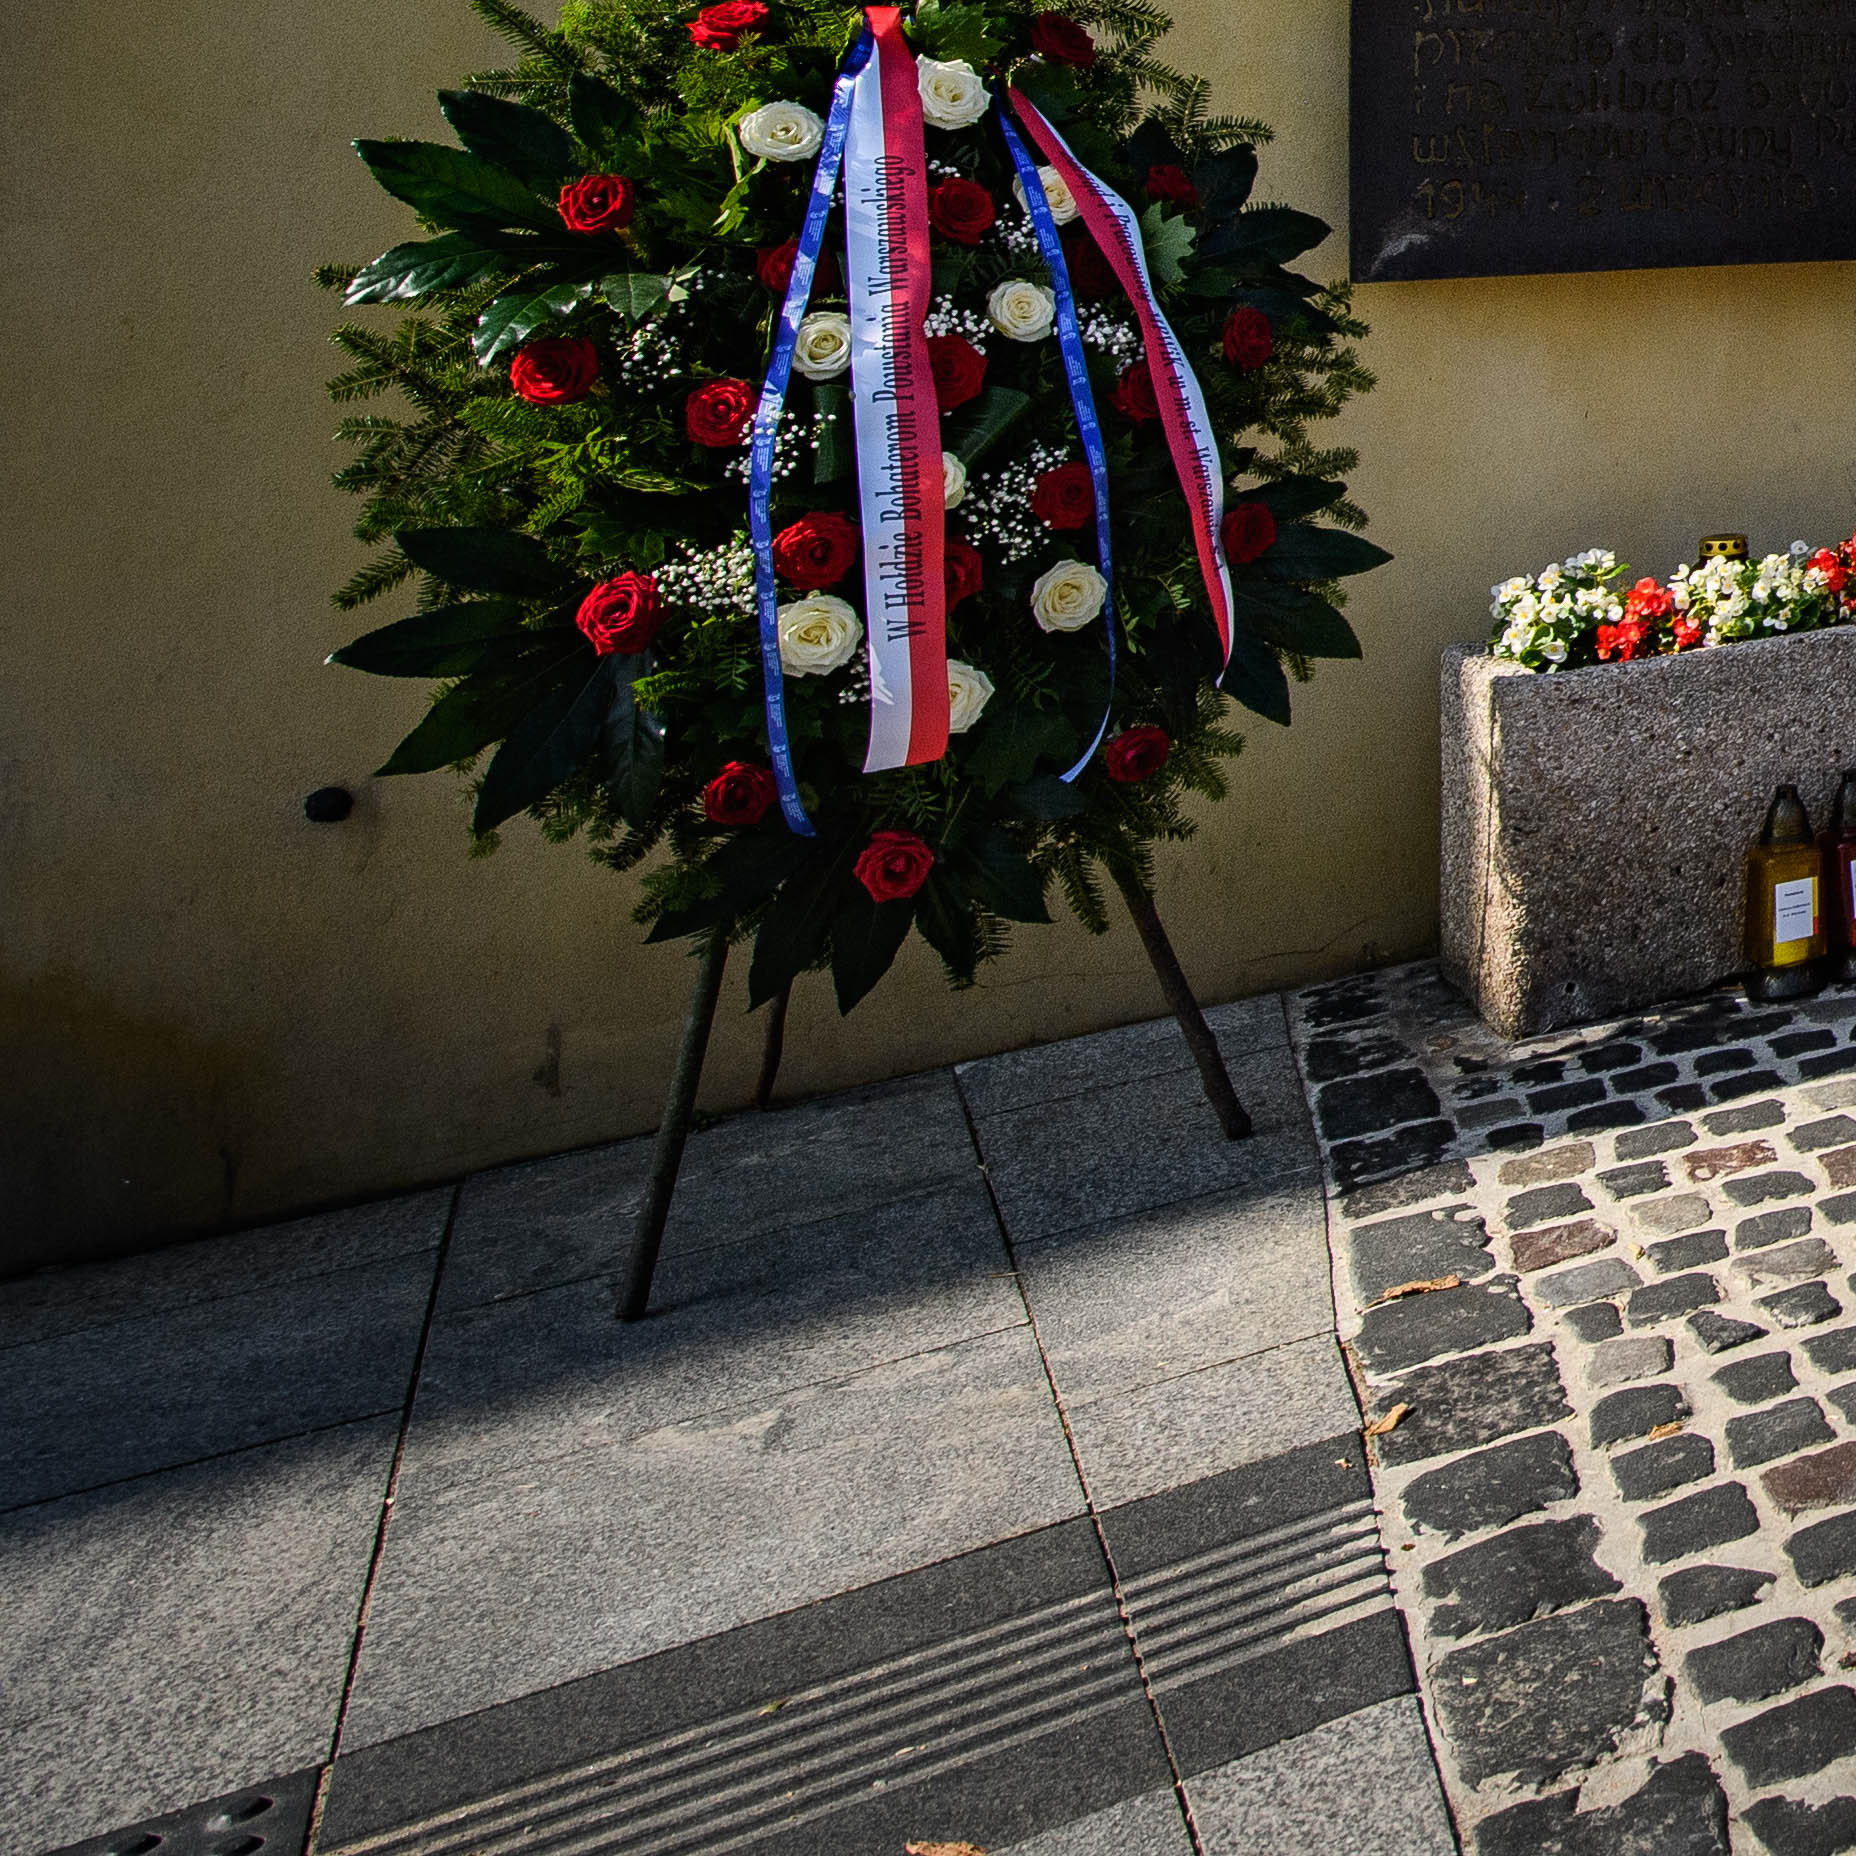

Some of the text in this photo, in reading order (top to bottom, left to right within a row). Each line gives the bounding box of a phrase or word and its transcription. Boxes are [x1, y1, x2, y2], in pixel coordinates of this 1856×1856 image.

[860, 153, 928, 643] W Hołdzie Bohaterom Powstania Warszawskiego
